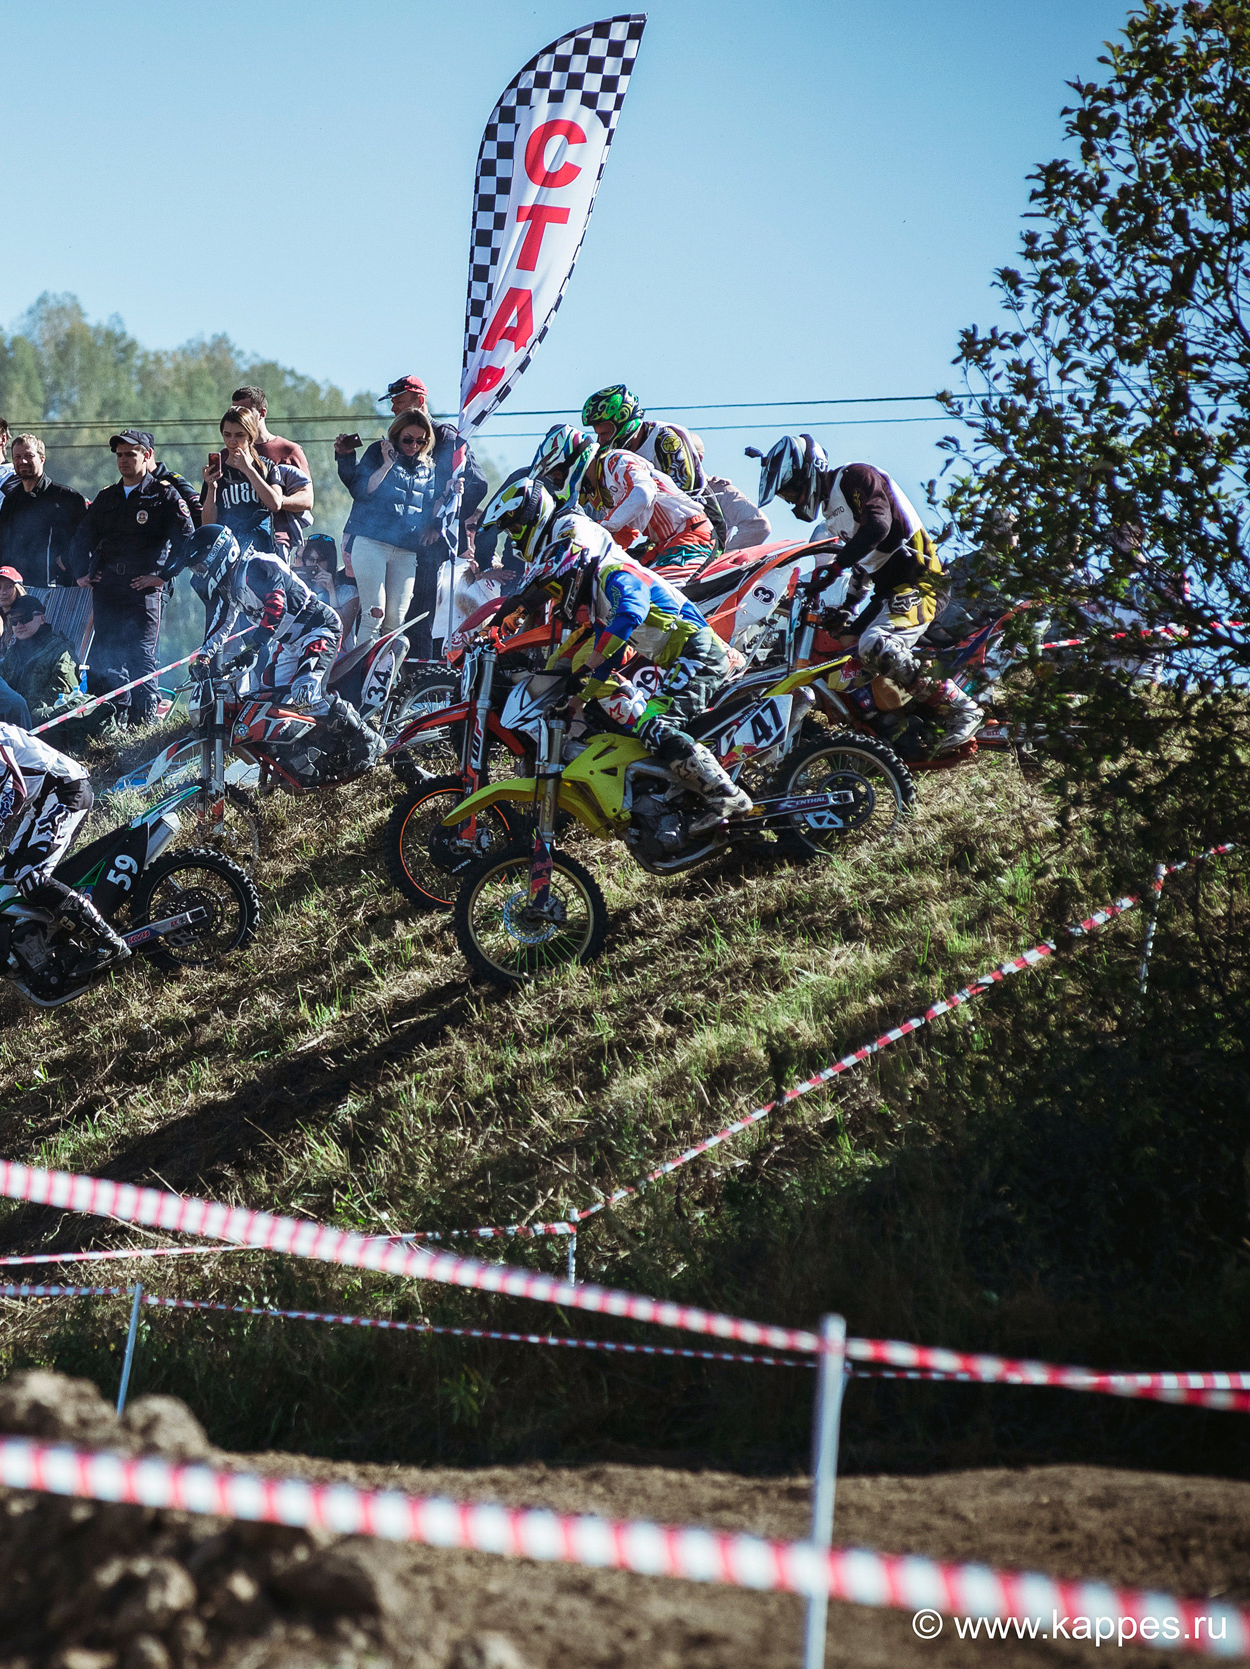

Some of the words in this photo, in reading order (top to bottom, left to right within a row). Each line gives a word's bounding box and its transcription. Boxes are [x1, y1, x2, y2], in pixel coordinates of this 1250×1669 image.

[367, 669, 391, 703] 34
[751, 699, 784, 747] 47
[106, 854, 138, 891] 59
